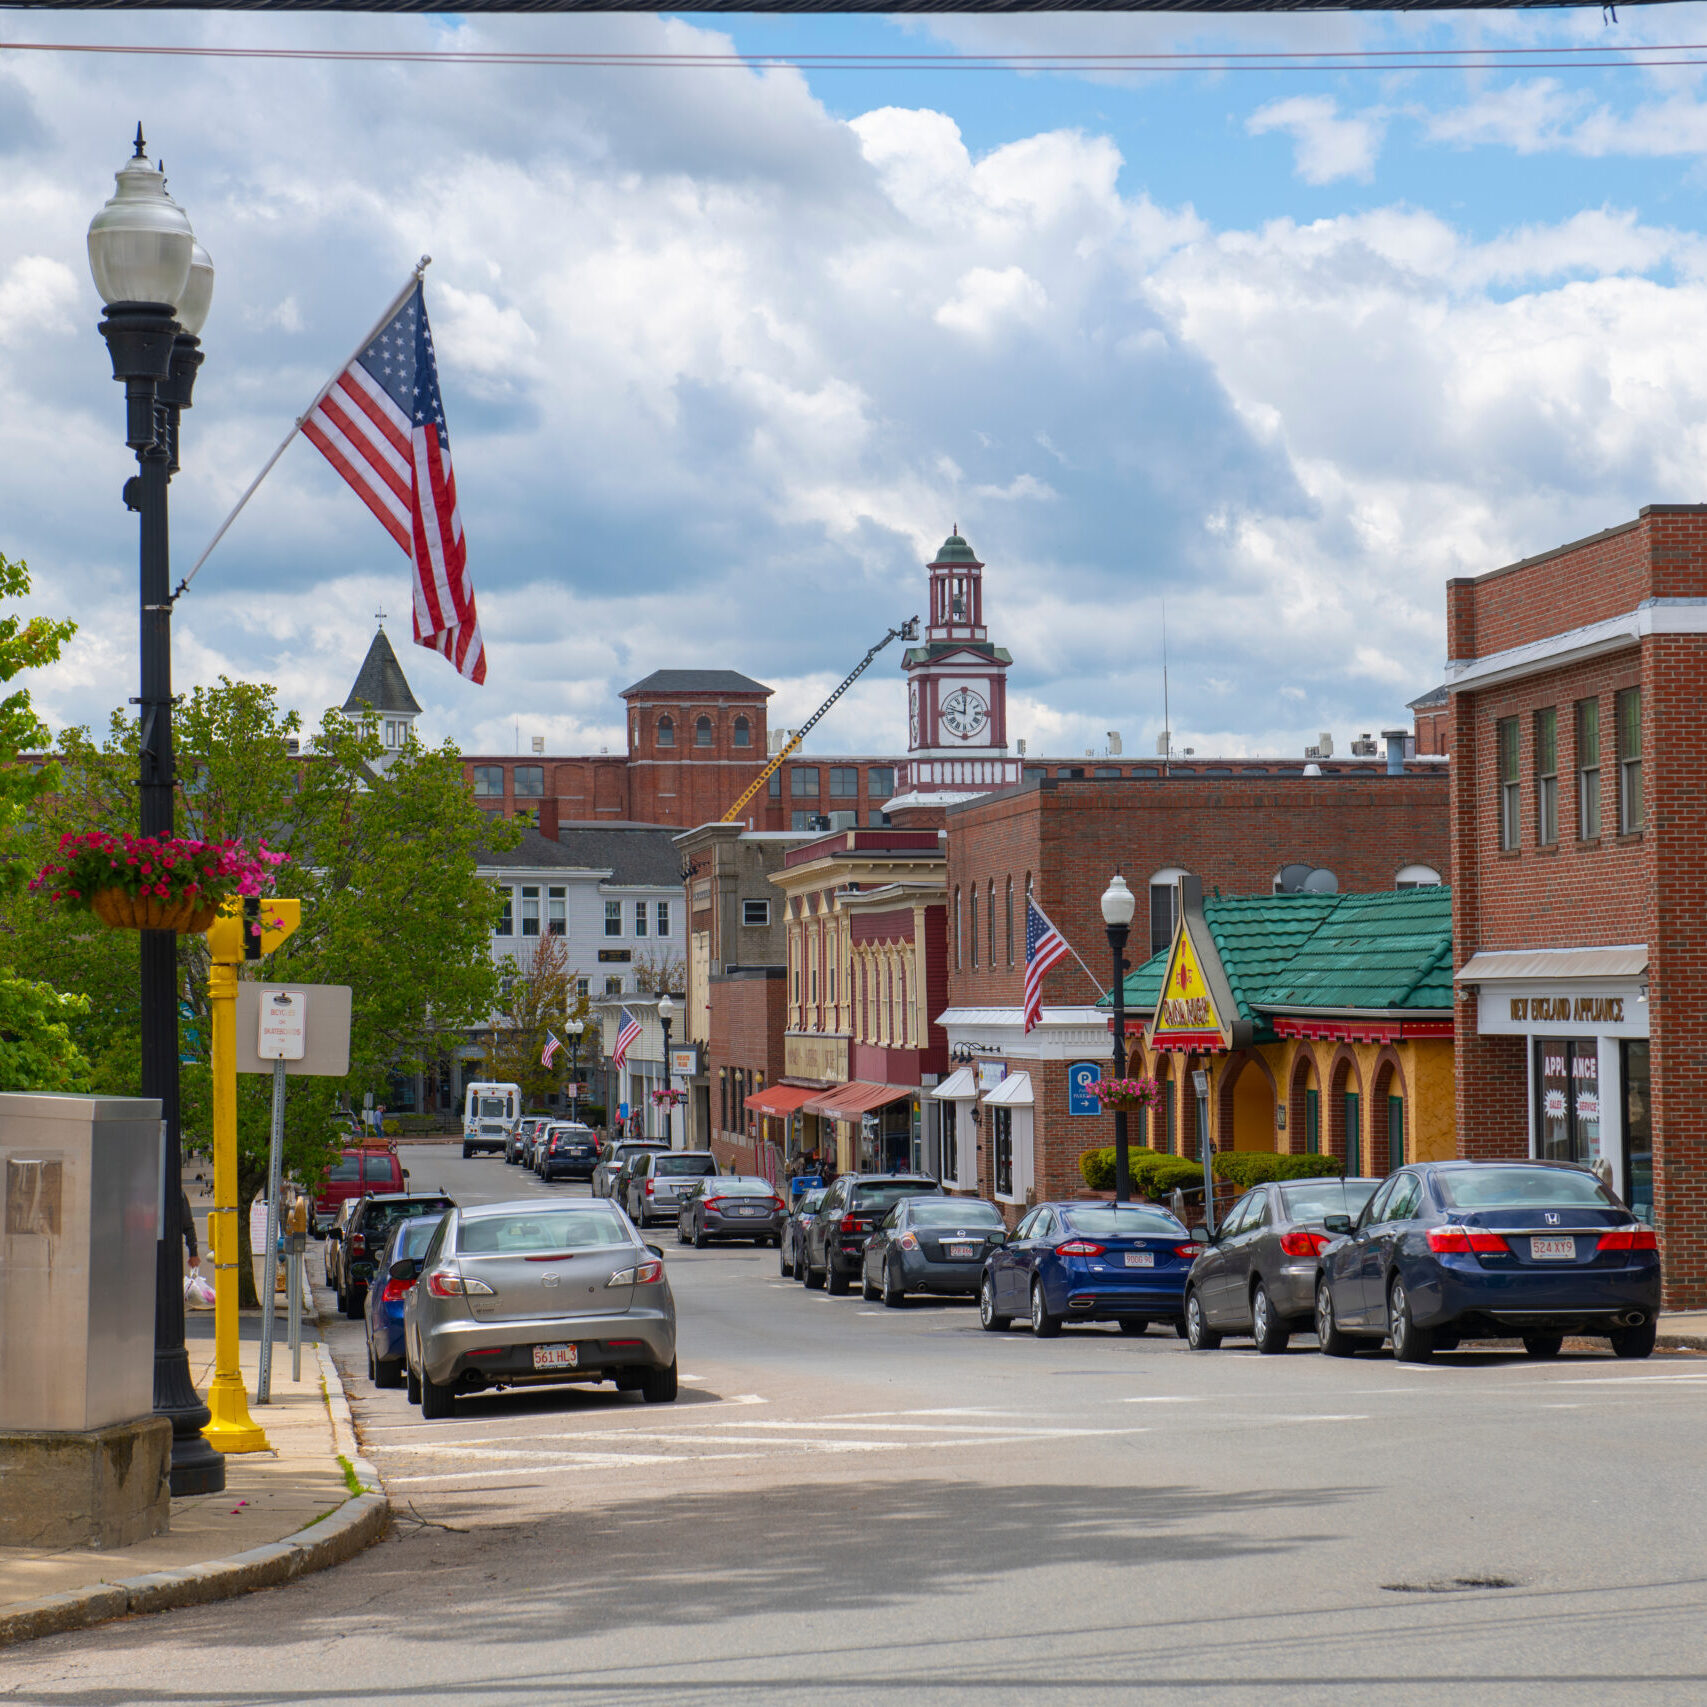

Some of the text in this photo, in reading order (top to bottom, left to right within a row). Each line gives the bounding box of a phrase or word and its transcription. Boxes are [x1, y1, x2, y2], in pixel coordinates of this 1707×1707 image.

[1510, 997, 1625, 1022] NEW ENGLAND APPLIANCE
[1579, 1101, 1597, 1112] SERVICE
[1533, 1241, 1573, 1253] 524 XY9
[535, 1350, 577, 1364] 561 HL3
